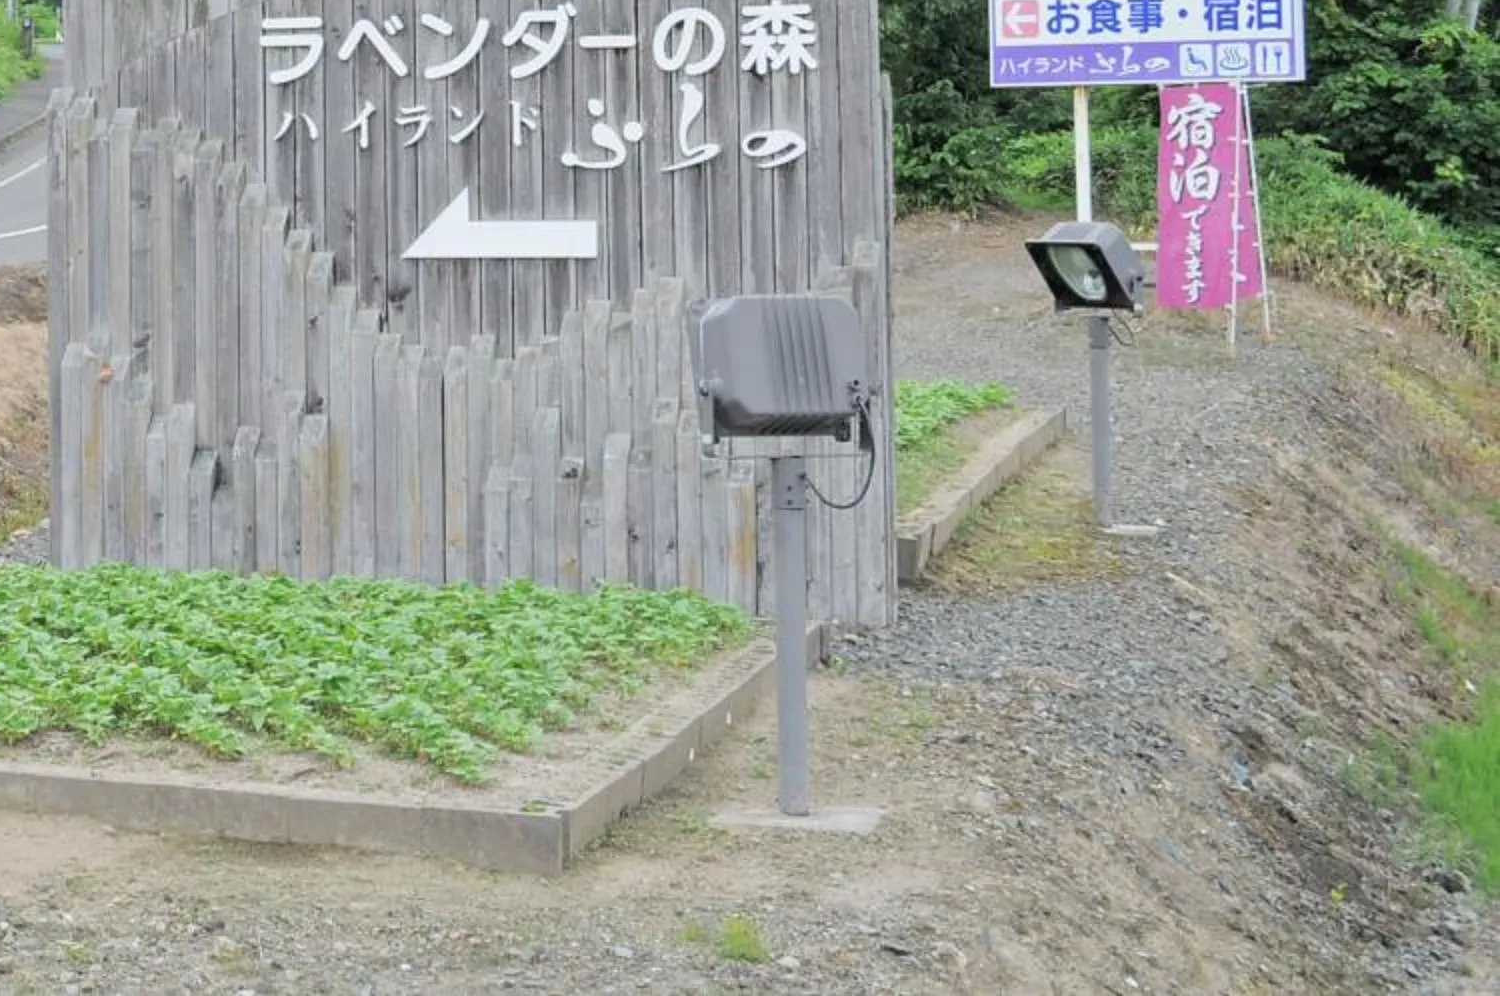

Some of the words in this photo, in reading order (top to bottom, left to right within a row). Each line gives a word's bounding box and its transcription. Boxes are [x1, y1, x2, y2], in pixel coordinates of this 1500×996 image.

[259, 0, 819, 84] ラベンダーの森
